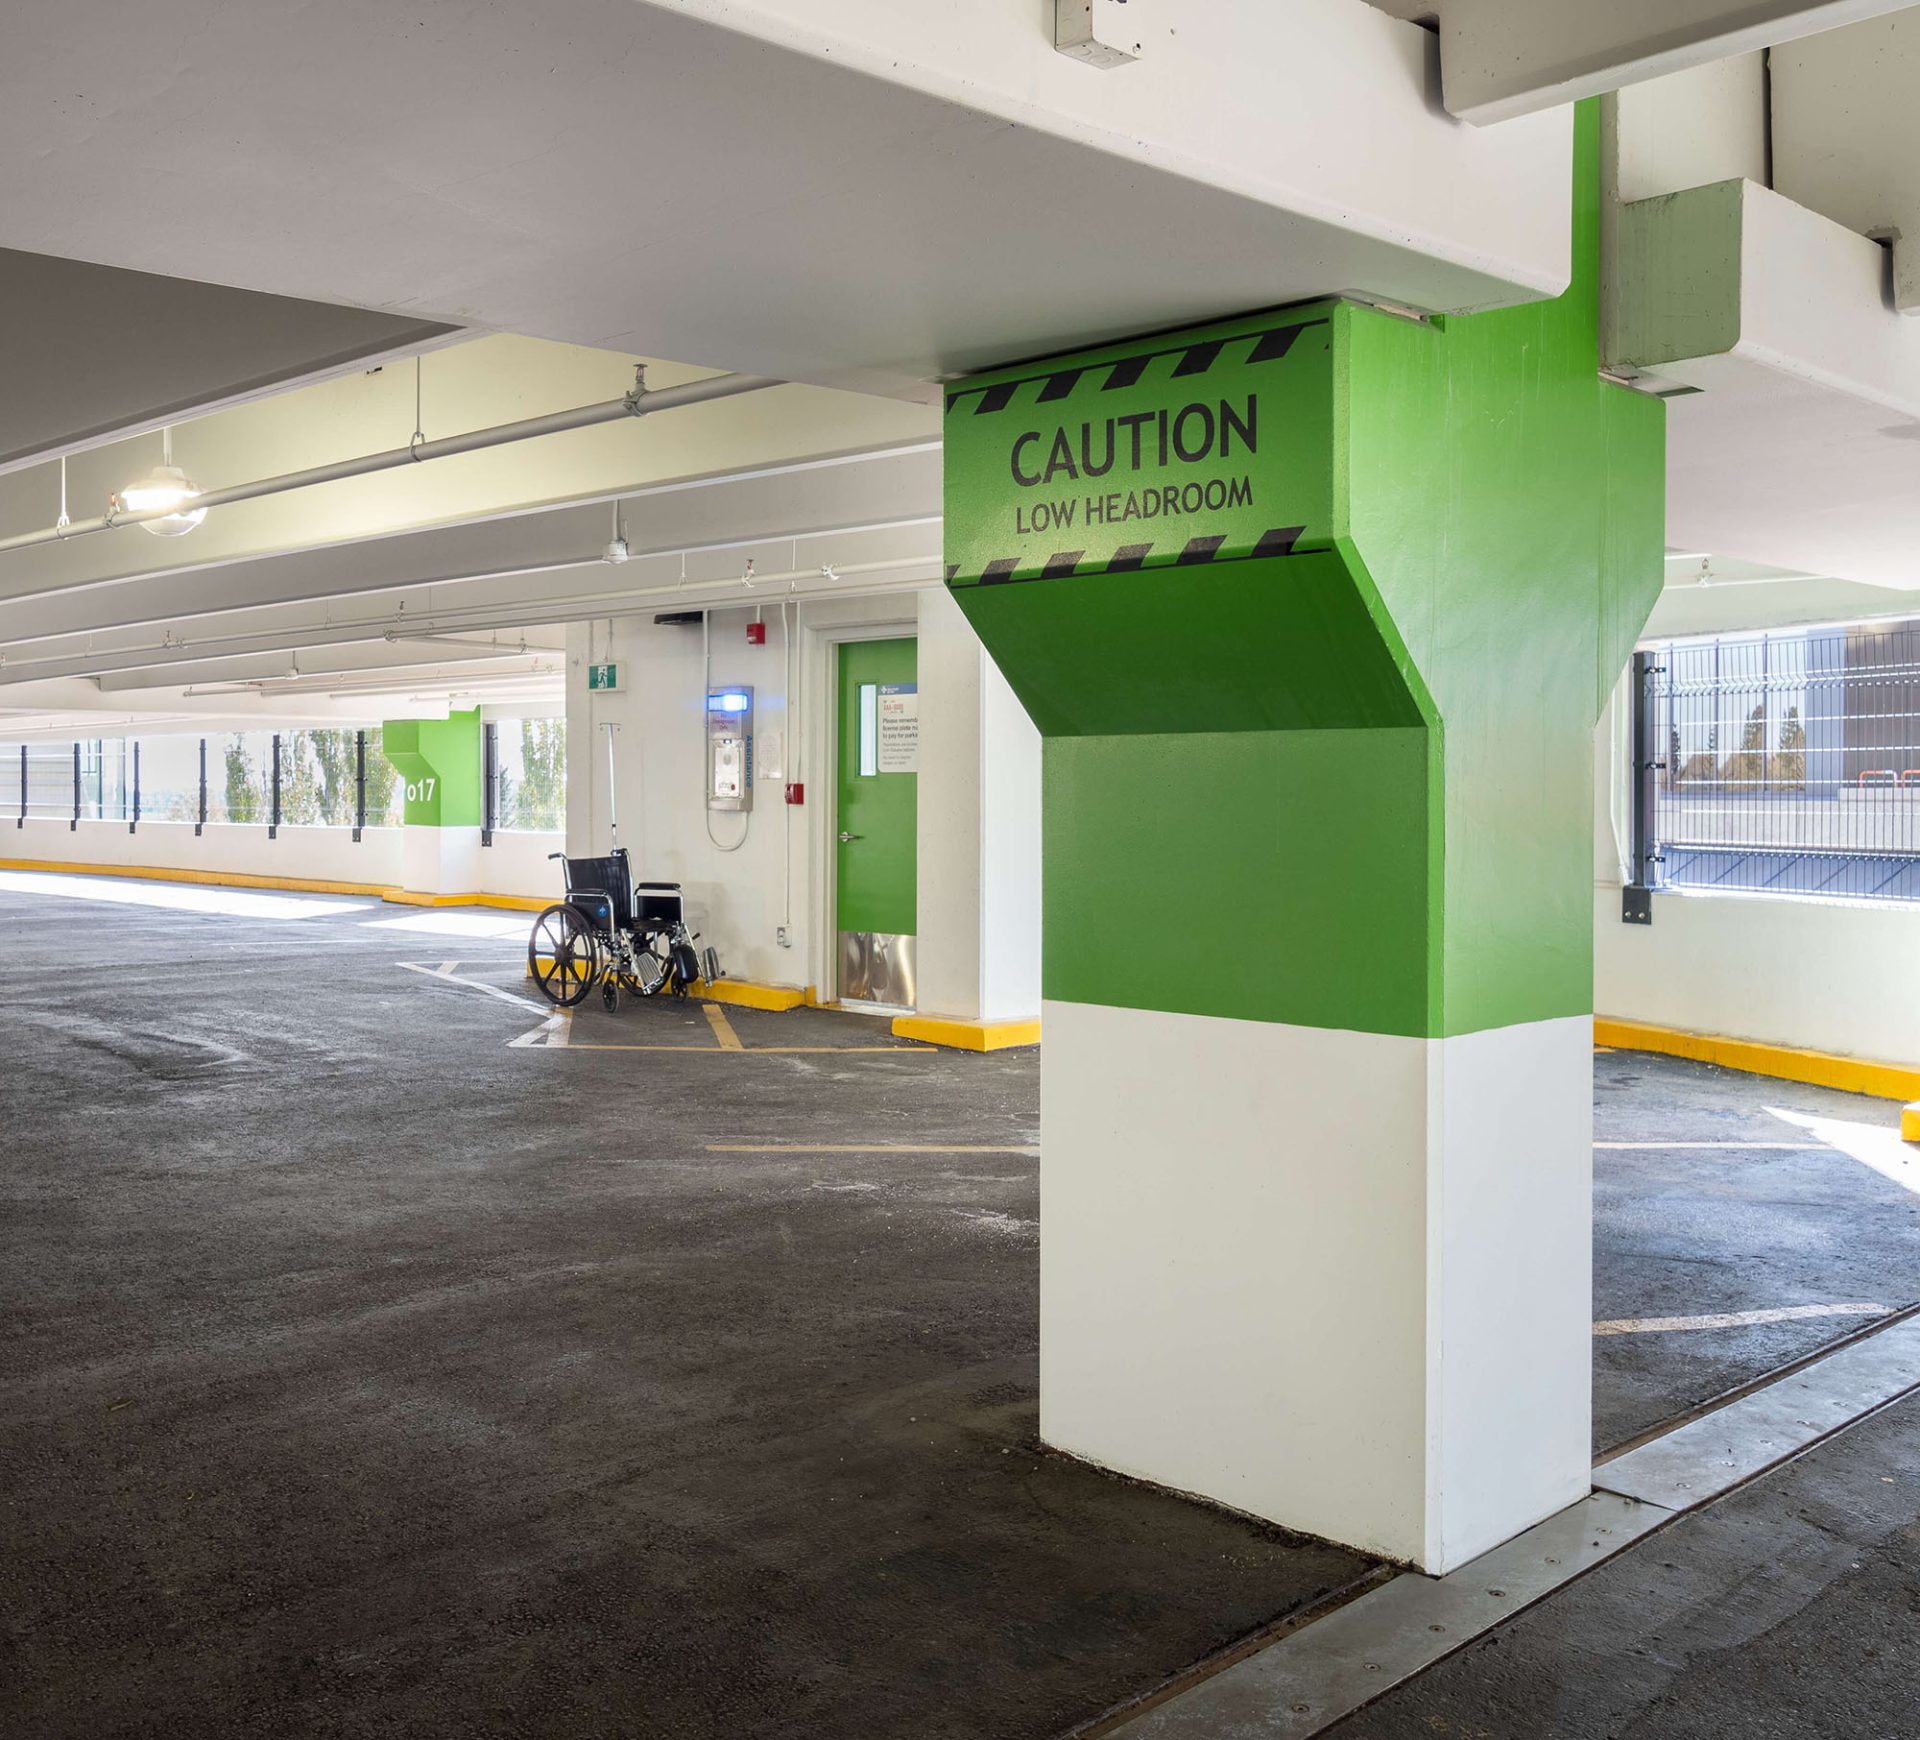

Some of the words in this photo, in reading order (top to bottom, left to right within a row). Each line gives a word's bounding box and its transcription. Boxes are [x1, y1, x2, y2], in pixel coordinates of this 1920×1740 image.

[1010, 394, 1258, 488] CAUTION
[1016, 499, 1077, 535] LOW
[1085, 475, 1254, 527] HEADROOM
